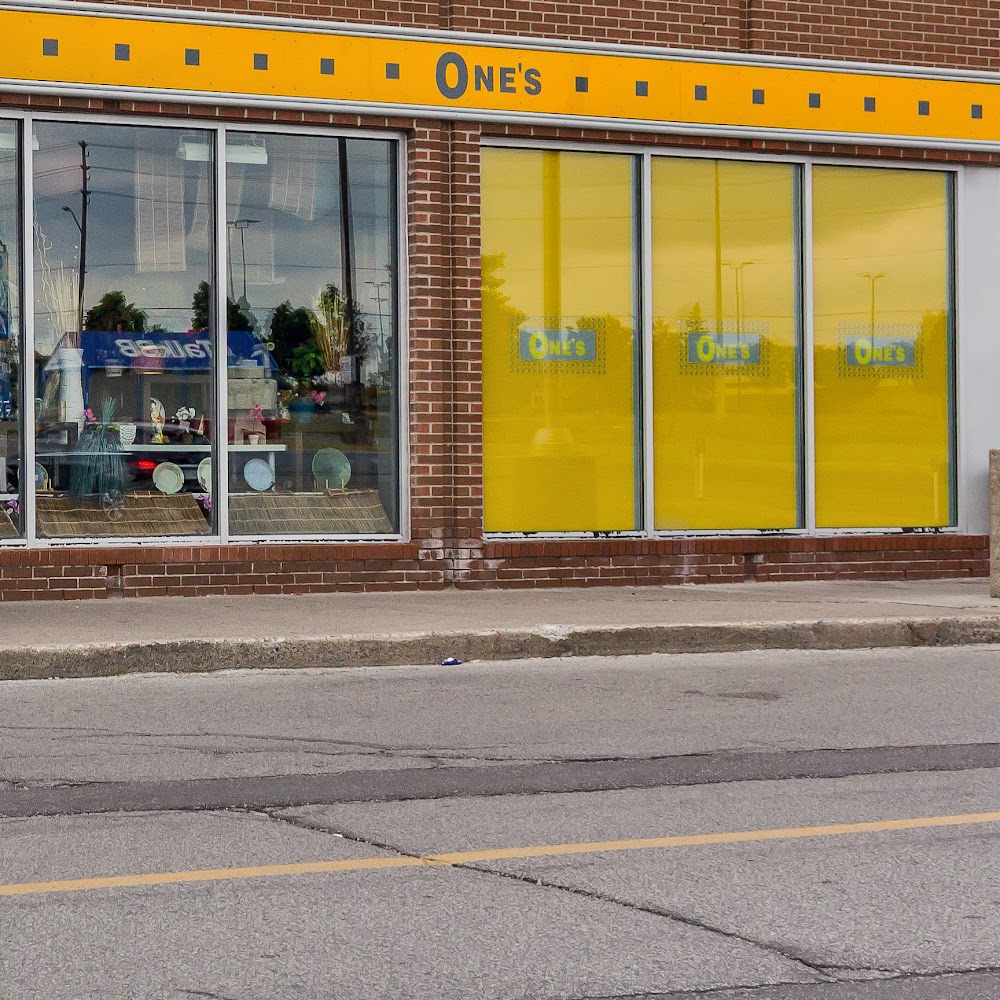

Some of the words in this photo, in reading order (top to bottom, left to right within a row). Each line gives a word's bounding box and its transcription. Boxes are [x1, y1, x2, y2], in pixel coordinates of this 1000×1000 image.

[436, 52, 542, 99] ONE'S
[529, 331, 586, 359] ONE'S
[697, 335, 751, 362] ONE'S
[855, 338, 906, 365] ONE'S
